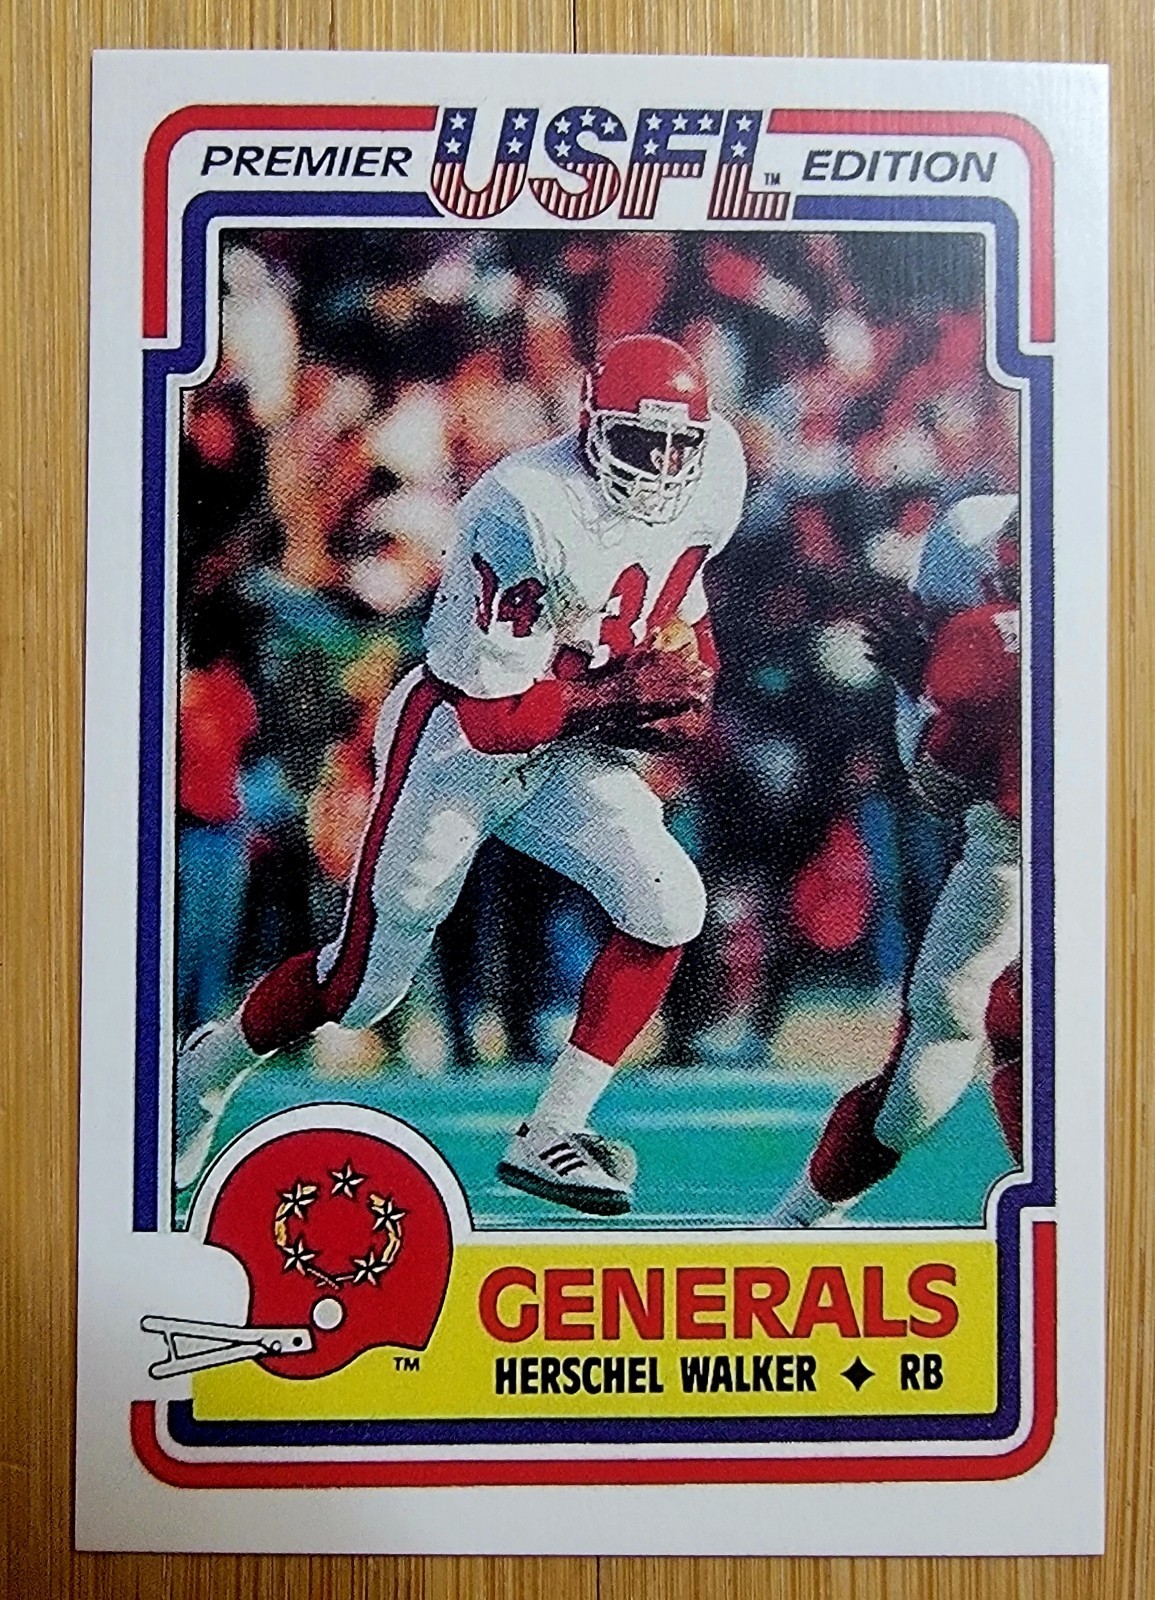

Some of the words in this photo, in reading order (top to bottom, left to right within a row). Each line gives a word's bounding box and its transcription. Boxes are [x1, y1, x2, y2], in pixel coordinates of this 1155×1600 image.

[201, 146, 413, 177] PREMIER
[430, 105, 791, 220] USFL
[801, 149, 997, 183] EDITION
[763, 172, 781, 186] TM
[478, 1263, 960, 1343] GENERALS
[393, 1356, 420, 1372] TM
[495, 1356, 665, 1395] HERSCHEL
[680, 1355, 817, 1394] WALKER
[900, 1353, 944, 1391] RB
